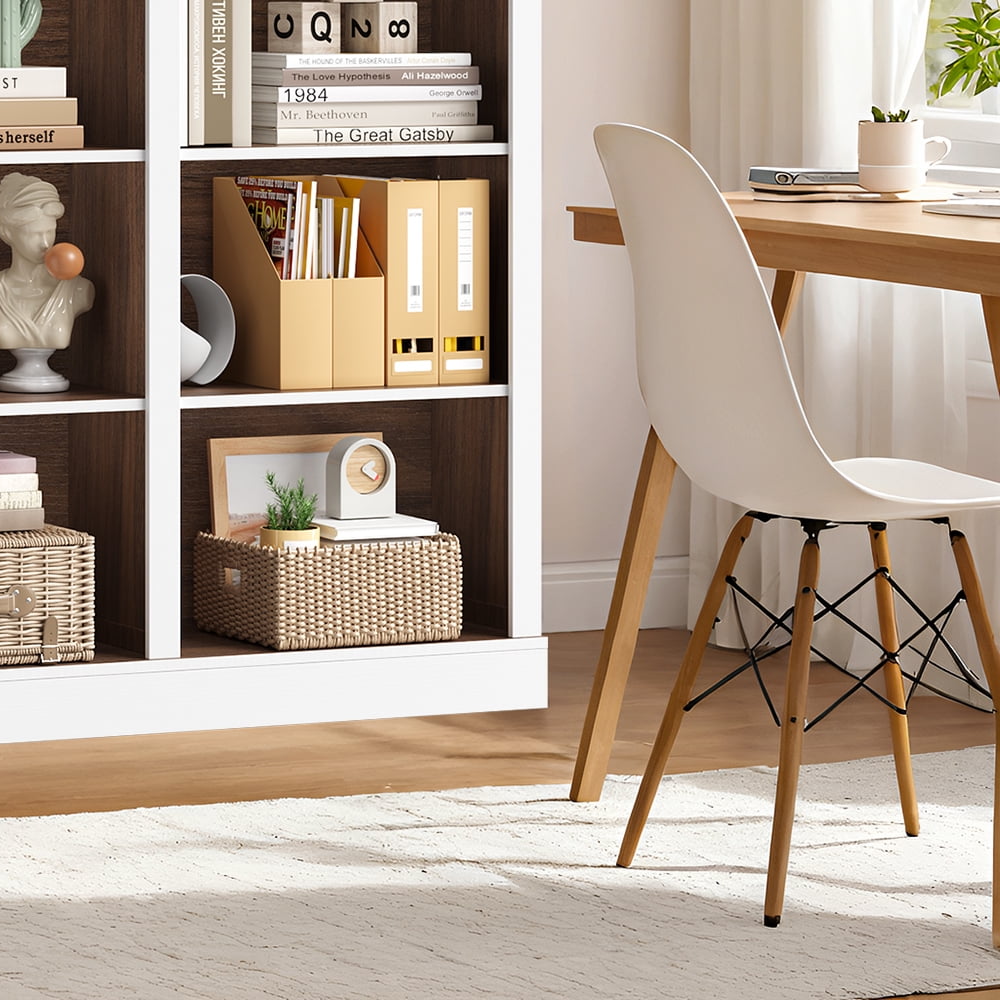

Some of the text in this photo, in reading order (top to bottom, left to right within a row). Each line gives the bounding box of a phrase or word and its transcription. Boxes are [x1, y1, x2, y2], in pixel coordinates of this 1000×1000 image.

[273, 13, 295, 39] C
[310, 11, 332, 43] Q
[351, 18, 372, 38] 2
[388, 18, 410, 39] 8
[298, 57, 402, 65] THE HOUND OF THE BASKERVILLES
[211, 47, 226, 99] ХОКИНГ
[291, 71, 469, 82] The Love Hypothesis Ali Hazelwood
[284, 87, 328, 103] 1984
[428, 89, 455, 97] George
[280, 110, 302, 120] Mr.
[306, 109, 368, 120] Beethoven
[313, 127, 455, 143] The Great Gatsby
